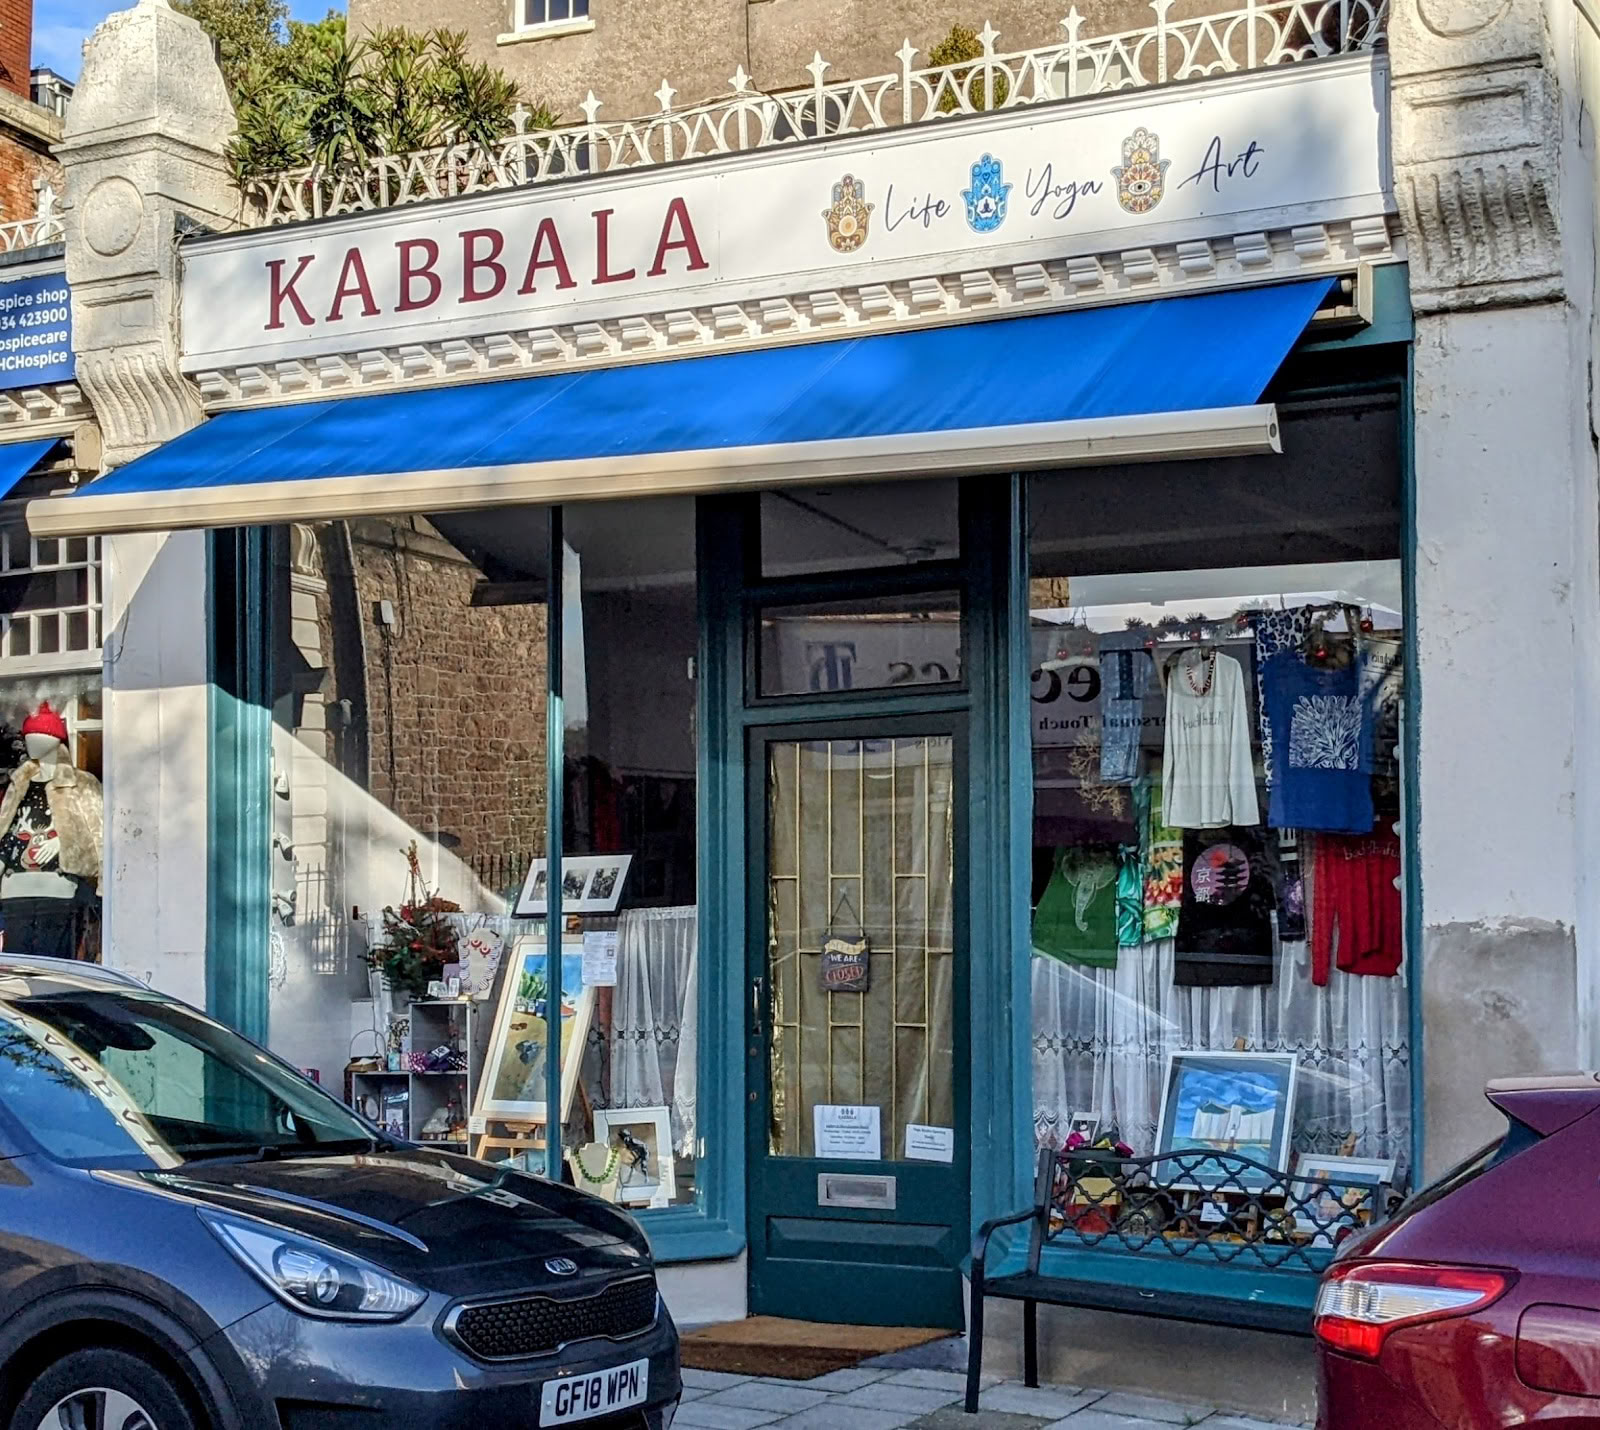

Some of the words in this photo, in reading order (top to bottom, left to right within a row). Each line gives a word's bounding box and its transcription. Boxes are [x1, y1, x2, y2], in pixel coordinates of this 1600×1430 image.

[884, 183, 951, 232] Life
[1025, 163, 1104, 219] Yoga
[1176, 135, 1265, 193] Art
[264, 197, 709, 330] KABBALA
[36, 289, 68, 304] shop
[19, 307, 68, 328] 423900
[830, 954, 843, 962] WE
[843, 955, 859, 963] ARE
[550, 1259, 575, 1272] KIA
[555, 1377, 602, 1417] GF18
[607, 1366, 639, 1405] WPN
